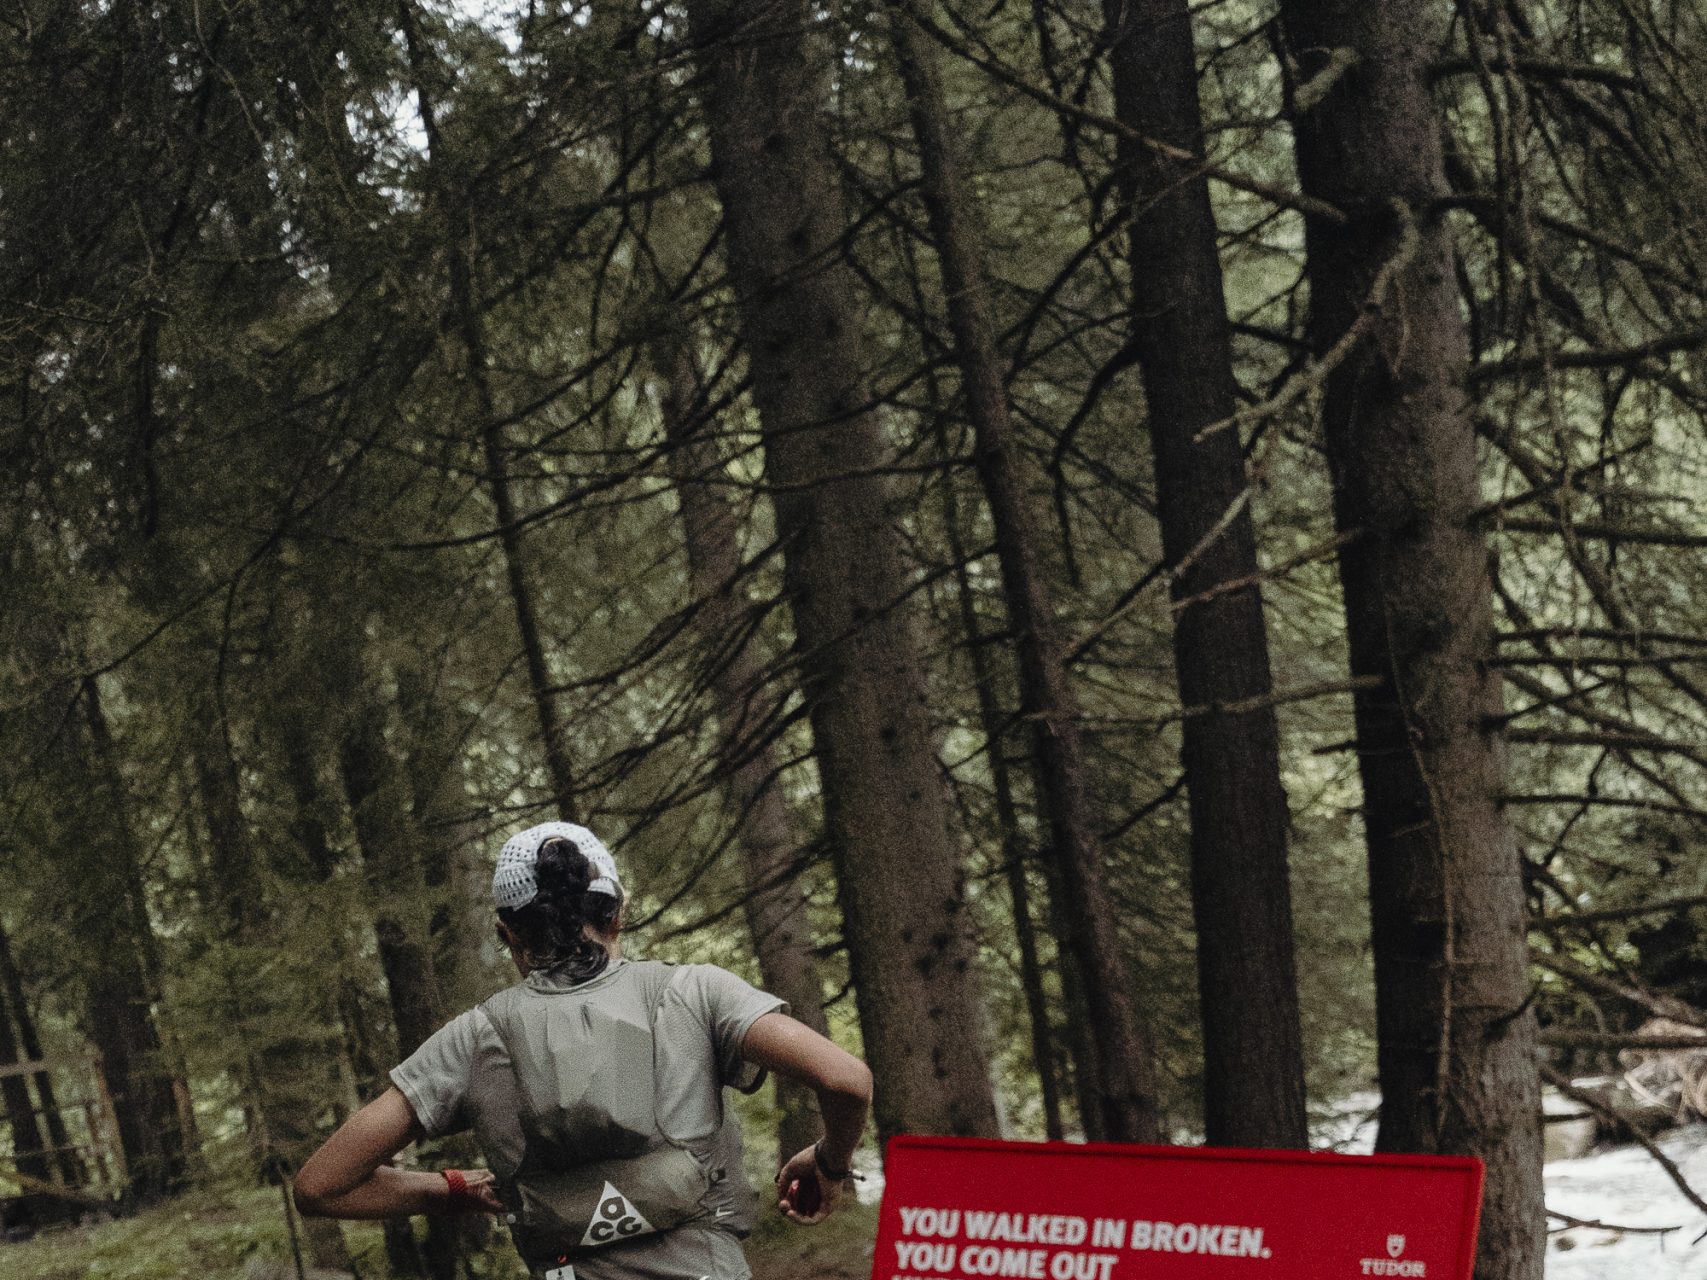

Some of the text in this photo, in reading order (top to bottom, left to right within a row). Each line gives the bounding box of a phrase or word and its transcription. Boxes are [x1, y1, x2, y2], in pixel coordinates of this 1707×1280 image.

[899, 1206, 1272, 1259] YOU WALKED IN BROKEN.
[894, 1240, 957, 1273] YOU
[959, 1245, 1049, 1280] COME
[1359, 1257, 1427, 1278] TUDOR
